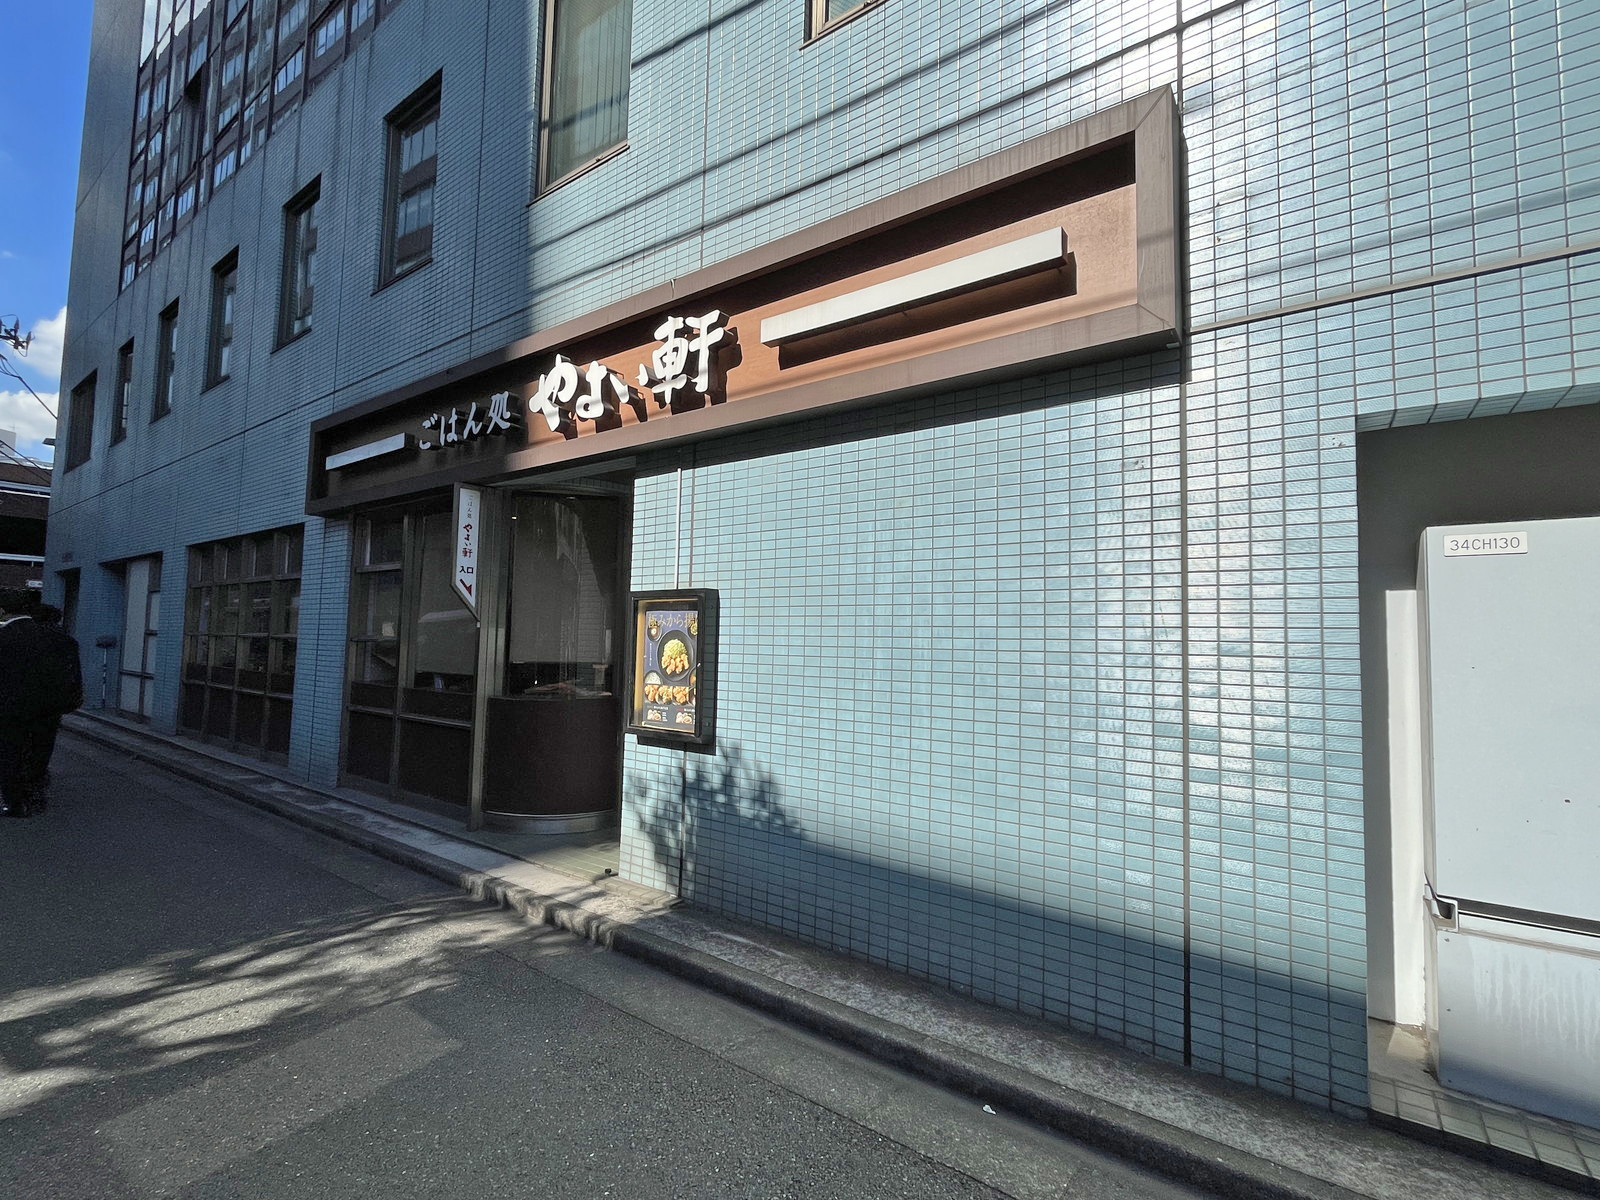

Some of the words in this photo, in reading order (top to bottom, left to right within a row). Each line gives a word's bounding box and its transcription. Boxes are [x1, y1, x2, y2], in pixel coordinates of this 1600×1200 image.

[419, 390, 511, 450] ごはん処
[529, 309, 726, 431] やよい軒
[462, 523, 473, 558] やよい軒
[1449, 536, 1521, 551] 34CH130
[459, 565, 474, 574] 入口
[648, 612, 698, 629] 極みから揚
